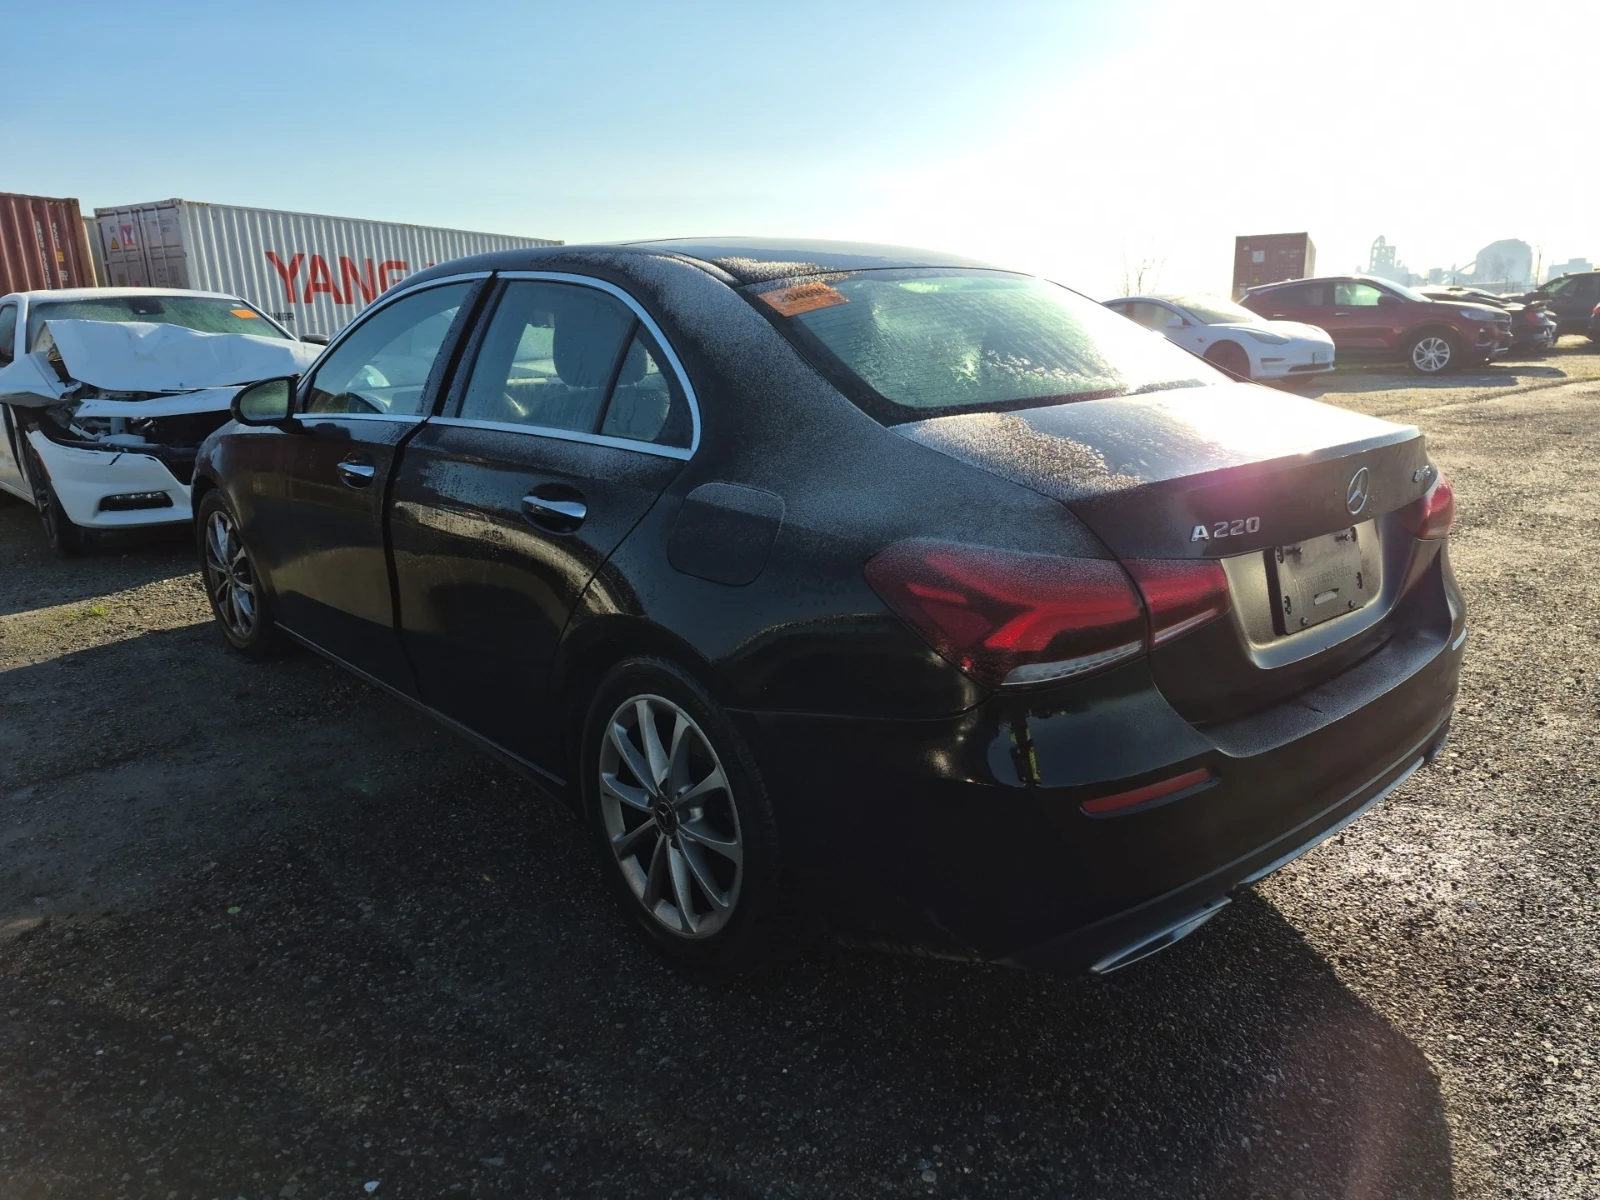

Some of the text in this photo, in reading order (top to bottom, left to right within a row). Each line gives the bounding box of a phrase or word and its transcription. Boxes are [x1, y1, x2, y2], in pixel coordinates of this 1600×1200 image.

[265, 251, 407, 305] YANG
[1189, 516, 1260, 542] A 220
